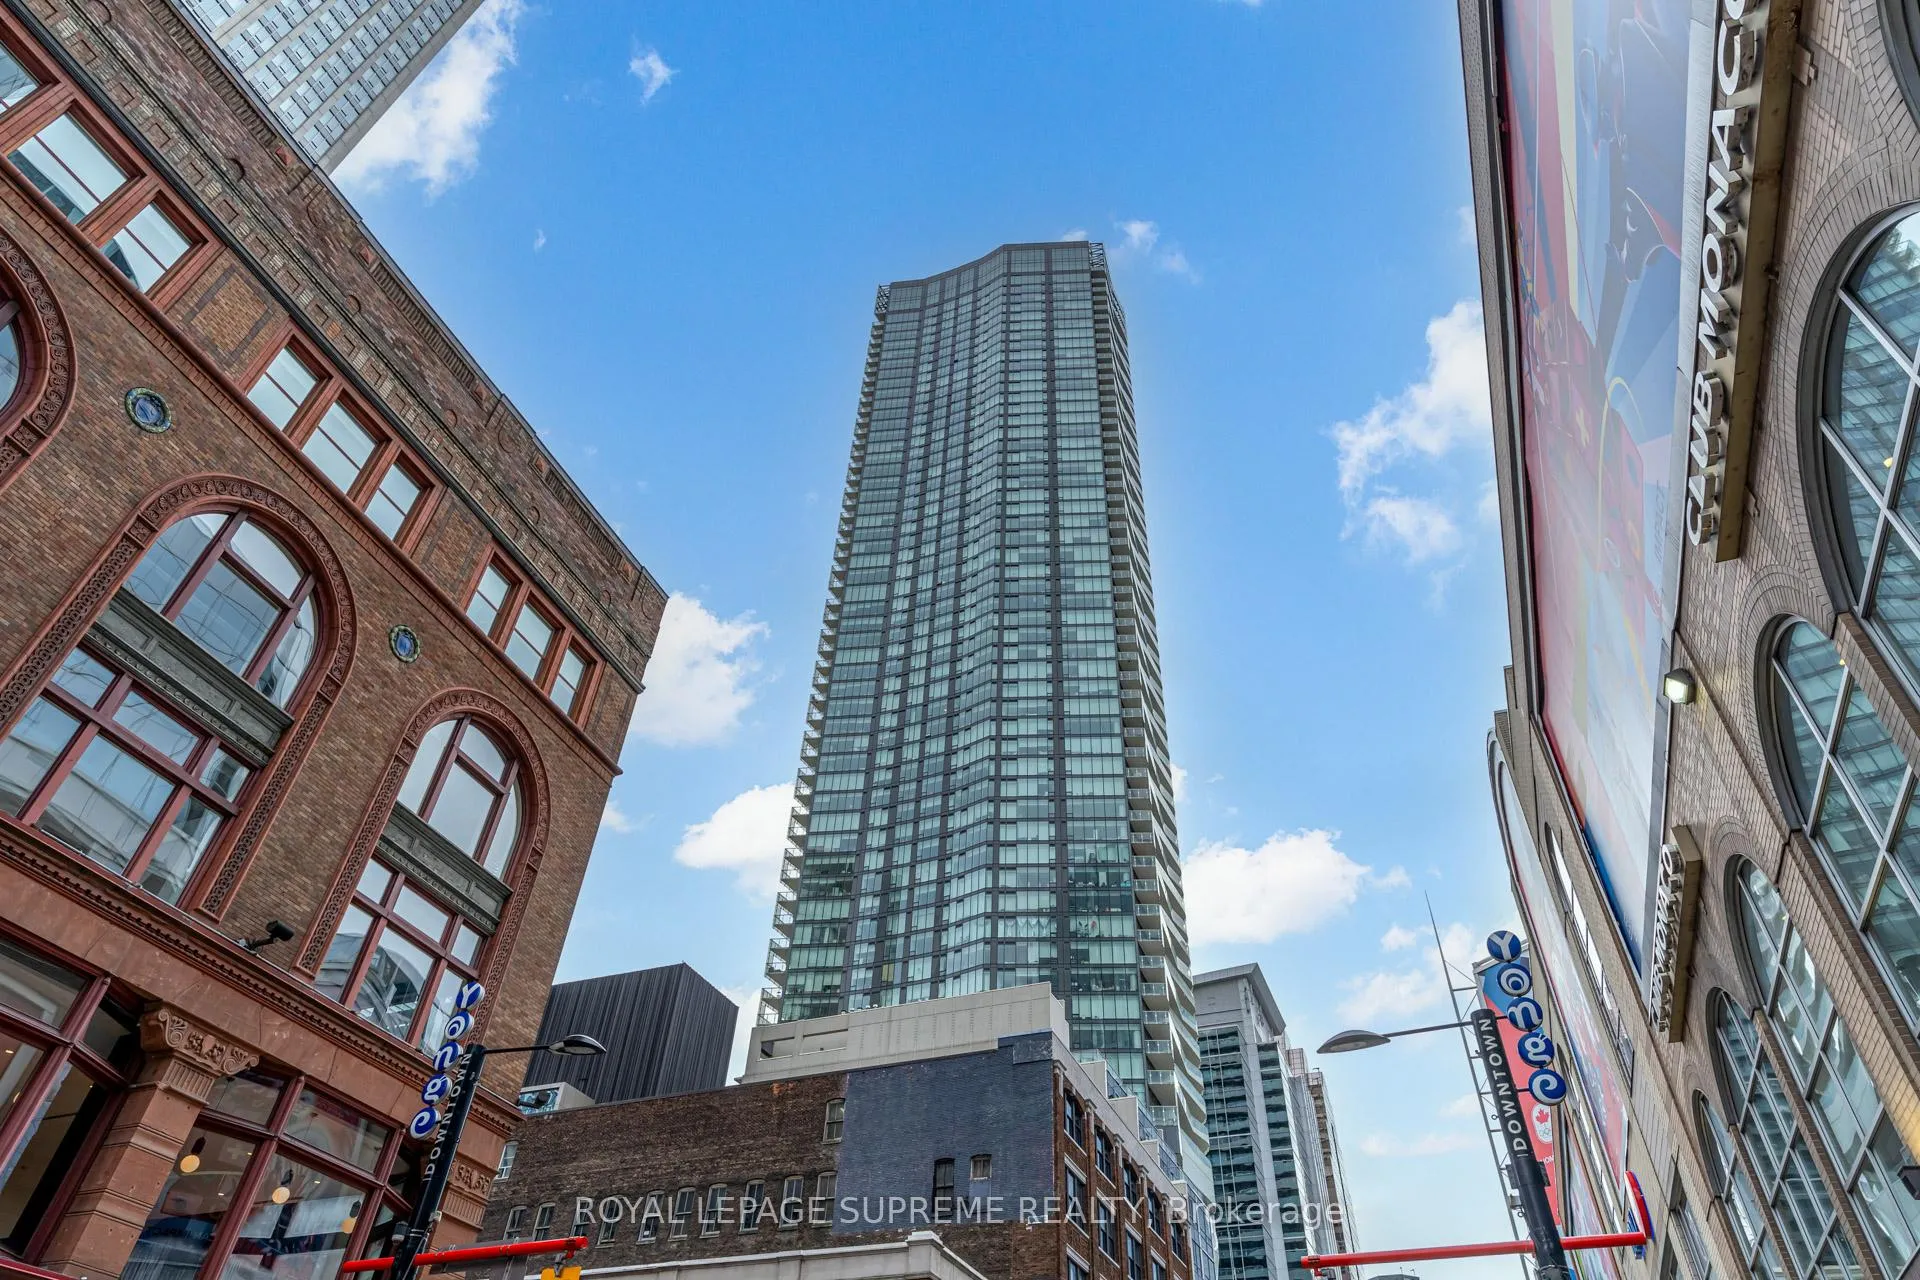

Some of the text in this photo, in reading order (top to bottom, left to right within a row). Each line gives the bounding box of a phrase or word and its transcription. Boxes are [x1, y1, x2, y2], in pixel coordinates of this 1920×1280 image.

[1687, 0, 1755, 546] CLUB MONAC
[1488, 931, 1566, 1105] Yonge
[1650, 843, 1681, 1032] CLUB MONACO
[410, 982, 484, 1139] Yonge
[424, 1052, 472, 1176] DOWNTOWN
[1479, 1018, 1528, 1151] DOWNTOWN
